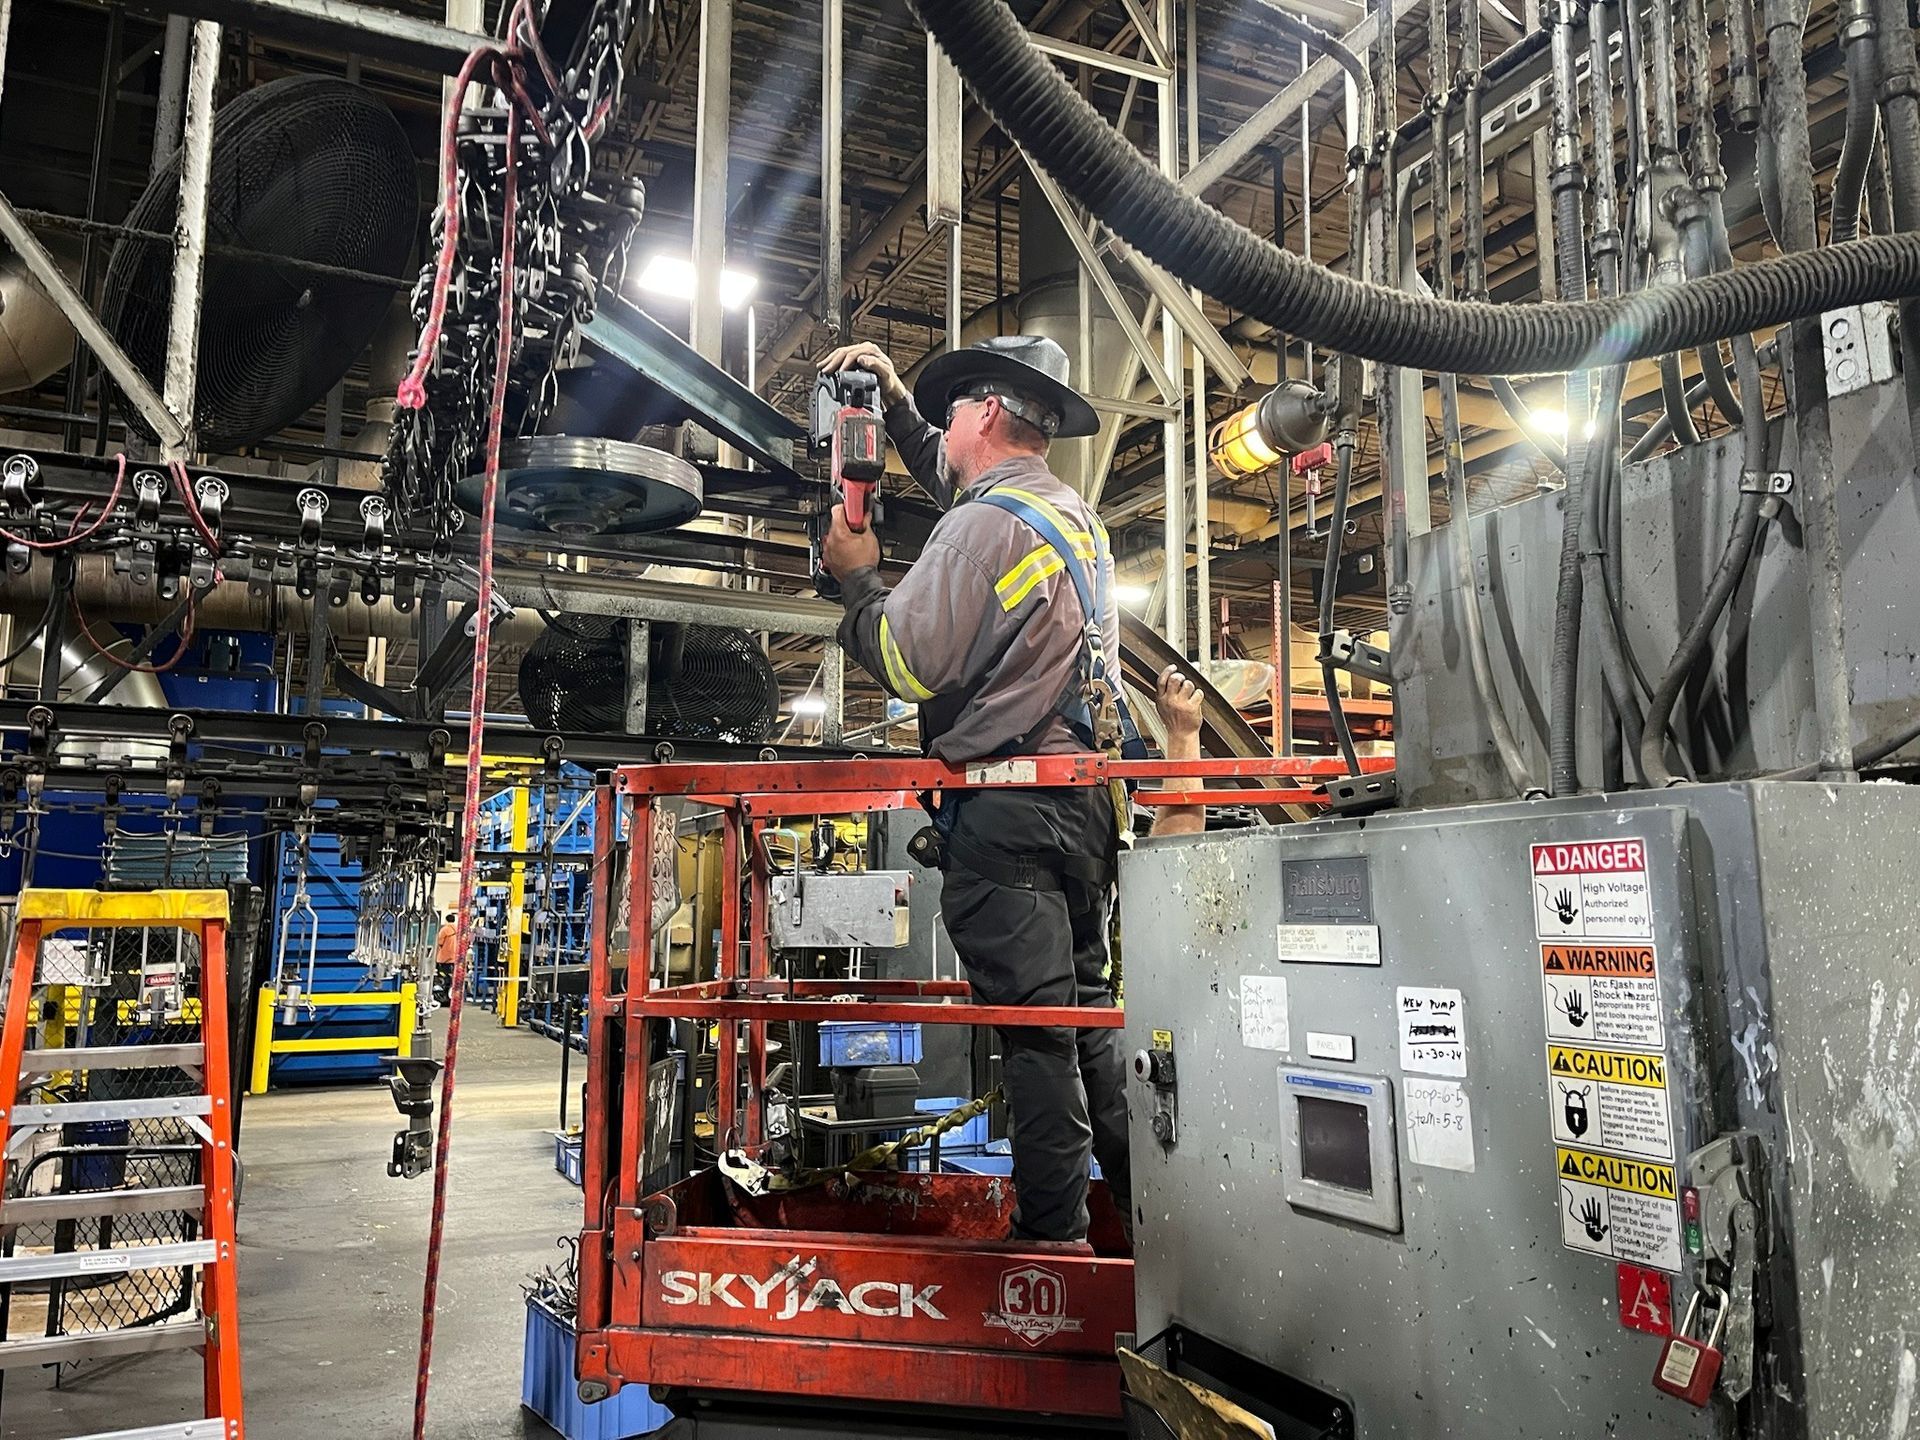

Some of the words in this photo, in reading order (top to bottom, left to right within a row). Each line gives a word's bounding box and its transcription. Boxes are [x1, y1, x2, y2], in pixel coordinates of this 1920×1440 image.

[1556, 843, 1643, 870] DANGER
[1583, 883, 1605, 895] High
[1609, 882, 1644, 894] Voltage
[1584, 900, 1628, 908] Authorized
[1586, 914, 1626, 924] personnel
[1567, 950, 1653, 972] WARNING
[1593, 980, 1607, 988] Arc
[1610, 980, 1634, 989] Flash
[1638, 982, 1654, 990] and
[1594, 990, 1620, 999] Shock
[1624, 992, 1655, 1001] Hazard
[1403, 997, 1422, 1008] NEW
[1430, 999, 1456, 1010] PUMP
[1594, 1000, 1633, 1010] Appropriate
[1636, 1002, 1650, 1010] PPE
[1628, 1013, 1657, 1022] required
[1596, 1030, 1608, 1038] this
[1611, 1032, 1648, 1040] equipment
[1572, 1052, 1662, 1082] CAUTION
[1621, 1088, 1655, 1099] proceeding
[1634, 1108, 1653, 1116] power
[1582, 1156, 1673, 1193] CAUTION
[1610, 1193, 1626, 1202] Area
[660, 1254, 950, 1321] SKYJACK
[1009, 1276, 1056, 1315] 30
[1629, 1280, 1662, 1325] A
